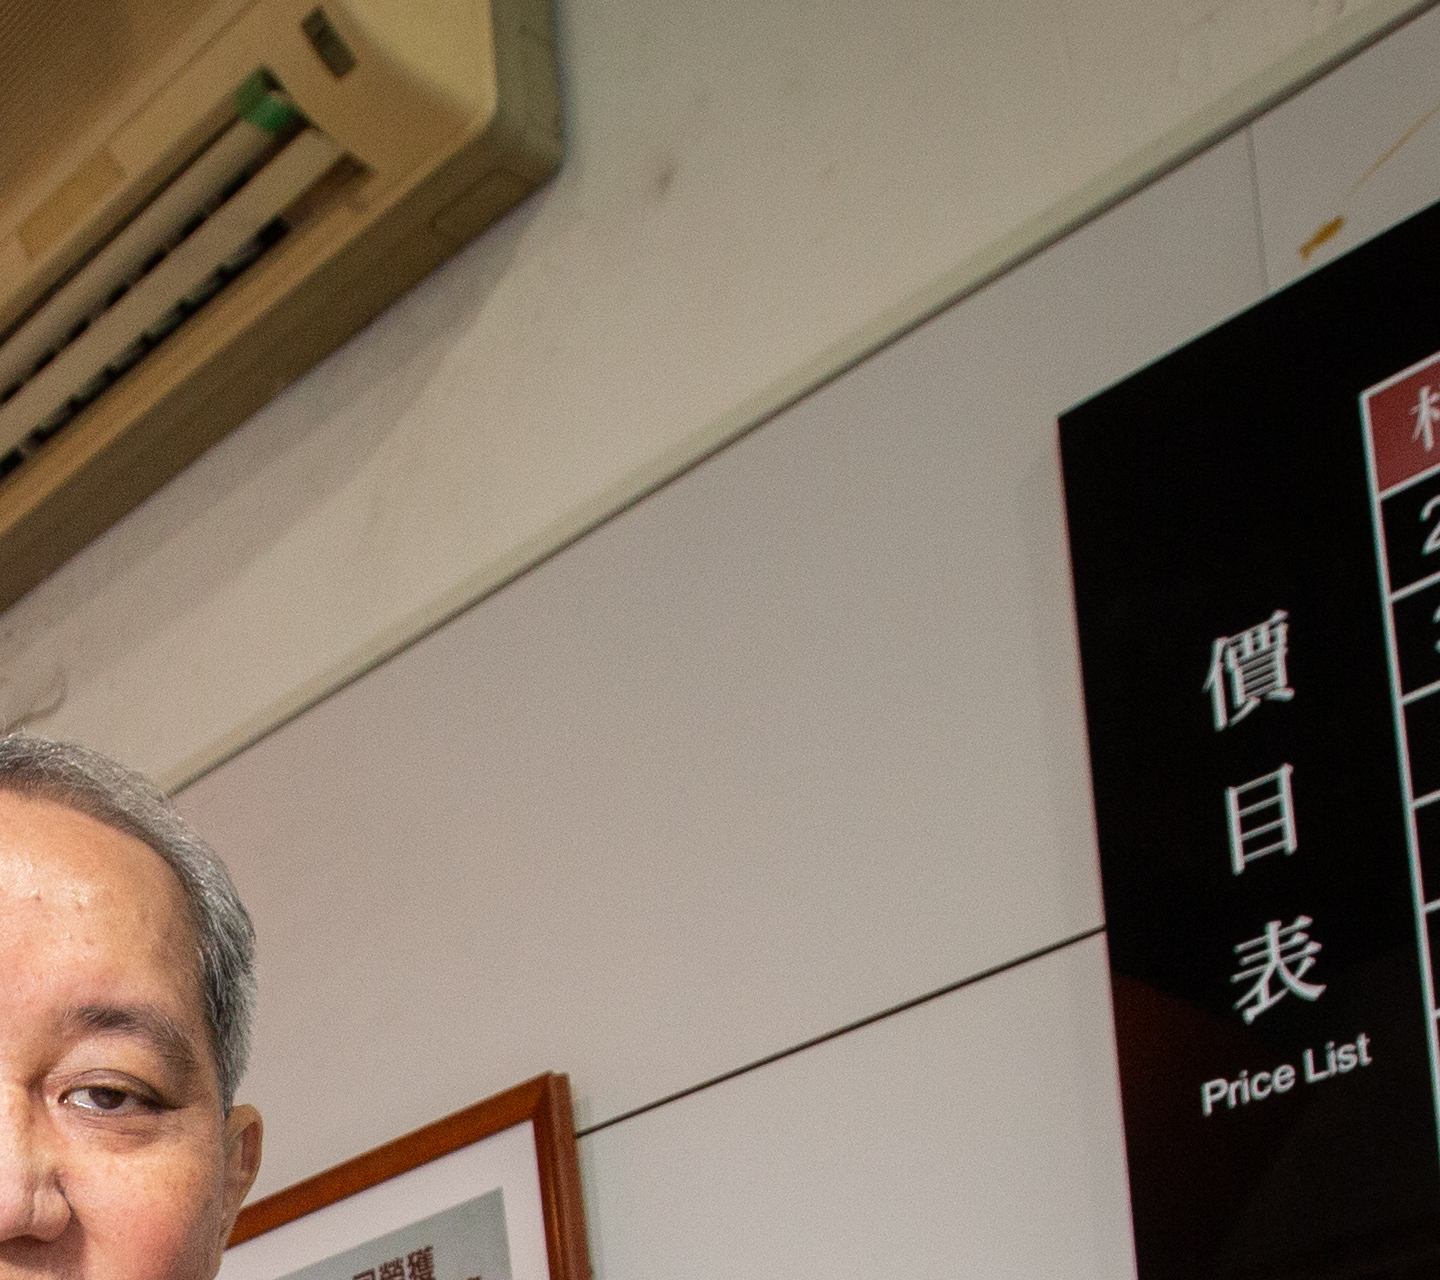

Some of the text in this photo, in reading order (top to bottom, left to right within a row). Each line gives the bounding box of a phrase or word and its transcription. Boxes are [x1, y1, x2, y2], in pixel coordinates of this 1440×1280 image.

[1200, 606, 1327, 1025] 價目表
[1200, 1032, 1373, 1116] Price List
